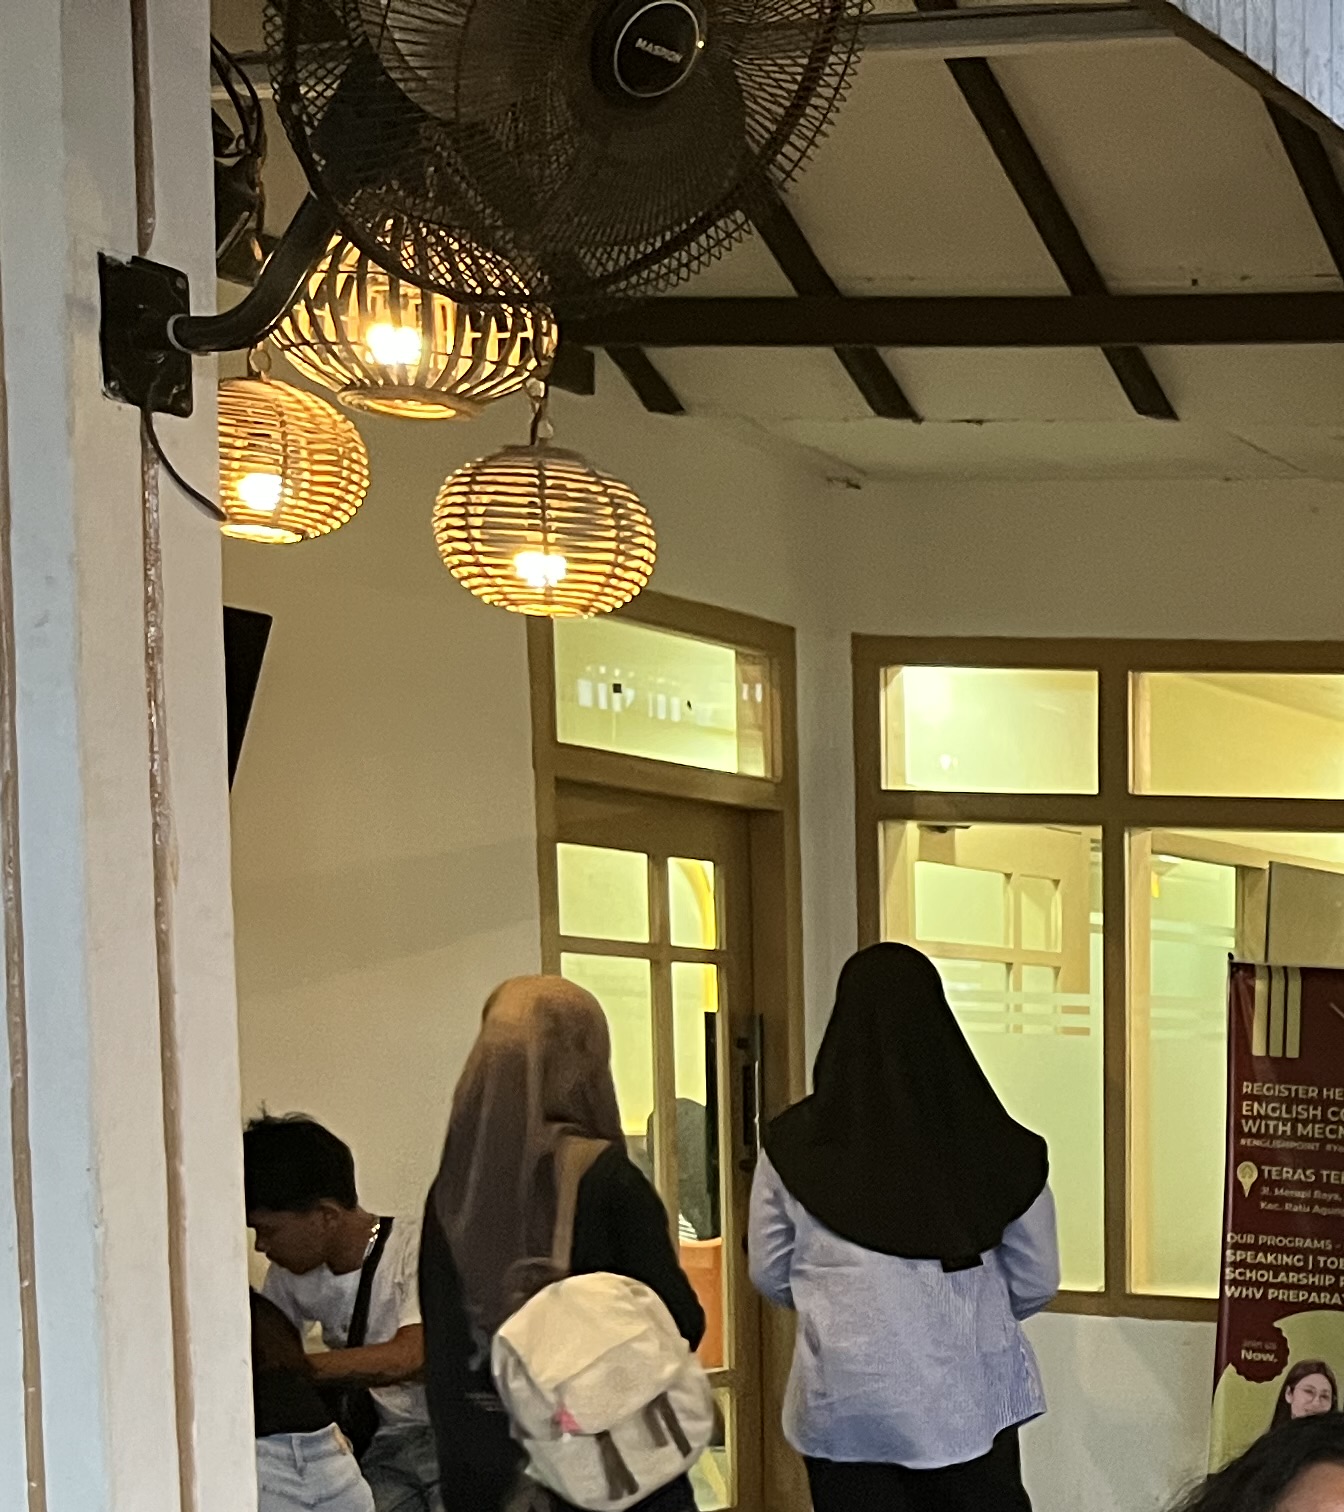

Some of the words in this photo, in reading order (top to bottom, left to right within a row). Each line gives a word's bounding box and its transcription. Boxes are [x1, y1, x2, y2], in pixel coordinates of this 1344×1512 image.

[1242, 1081, 1318, 1099] REGISTER
[1242, 1101, 1321, 1120] ENGLISH
[1241, 1119, 1291, 1136] WITH
[1261, 1165, 1316, 1182] TERAS
[1227, 1232, 1255, 1244] OUR
[1259, 1234, 1332, 1250] PROGRAMS
[1225, 1249, 1304, 1267] SPEAKING
[1225, 1267, 1336, 1287] SCHOLARSHIP
